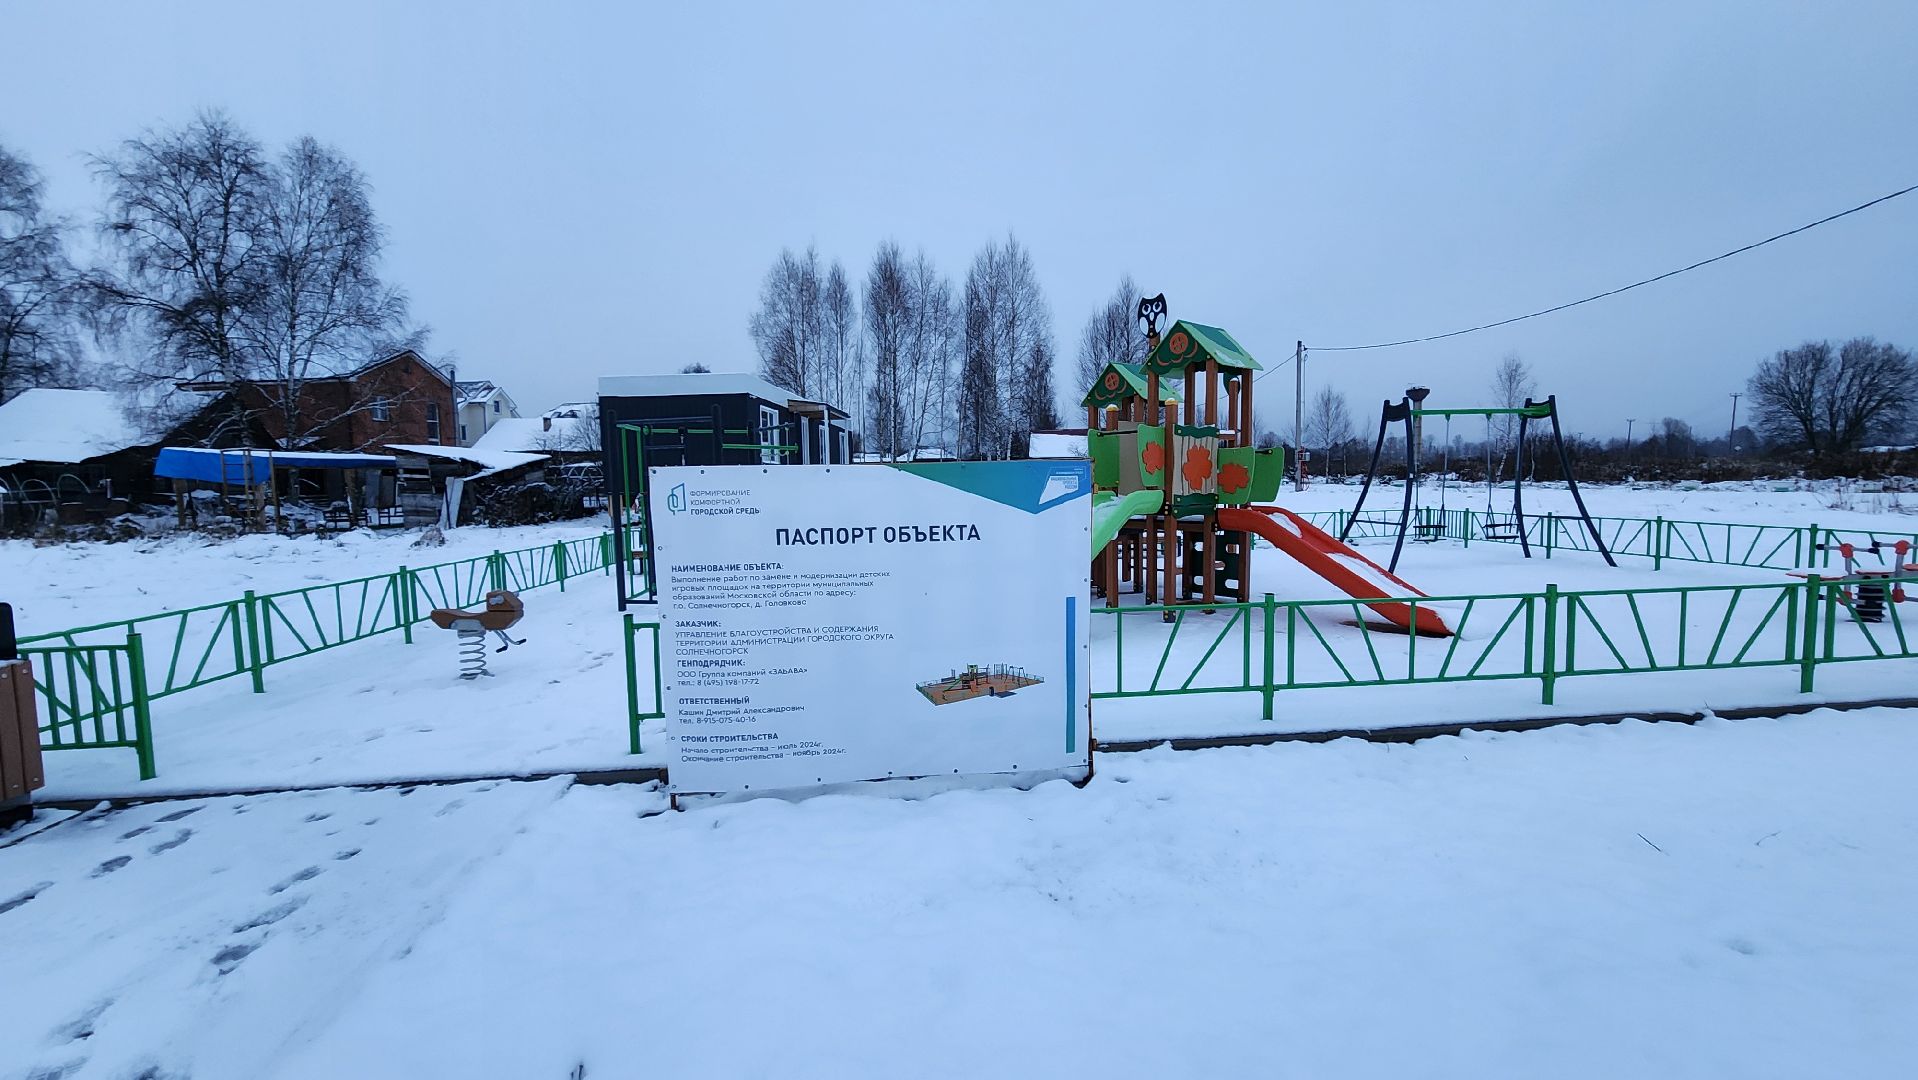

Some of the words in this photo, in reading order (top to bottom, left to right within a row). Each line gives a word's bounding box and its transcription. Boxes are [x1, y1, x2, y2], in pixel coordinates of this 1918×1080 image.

[691, 507, 733, 516] ГОРОДСКОЙ
[776, 527, 877, 546] ПАСПОРТ
[883, 524, 981, 543] ОБЪЕКТА
[671, 564, 741, 573] НАИМЕНОВАНИЕ
[743, 563, 784, 571] ОБЪЕКТА:
[727, 591, 777, 599] Московской
[779, 590, 812, 598] области
[729, 627, 812, 637] БЛАГОУСТРОЙСТВА
[730, 638, 806, 646] АДМИНИСТРАЦИИ
[677, 660, 746, 668] ГЕНПОДРЯДЧИК:
[698, 670, 725, 679] Группа
[703, 679, 723, 687] (495)
[679, 696, 750, 704] ОТВЕТСТВЕННЫЙ
[705, 708, 741, 716] Дмитрий
[743, 706, 805, 714] Александрович
[709, 733, 779, 742] СТРОИТЕЛЬСТВА
